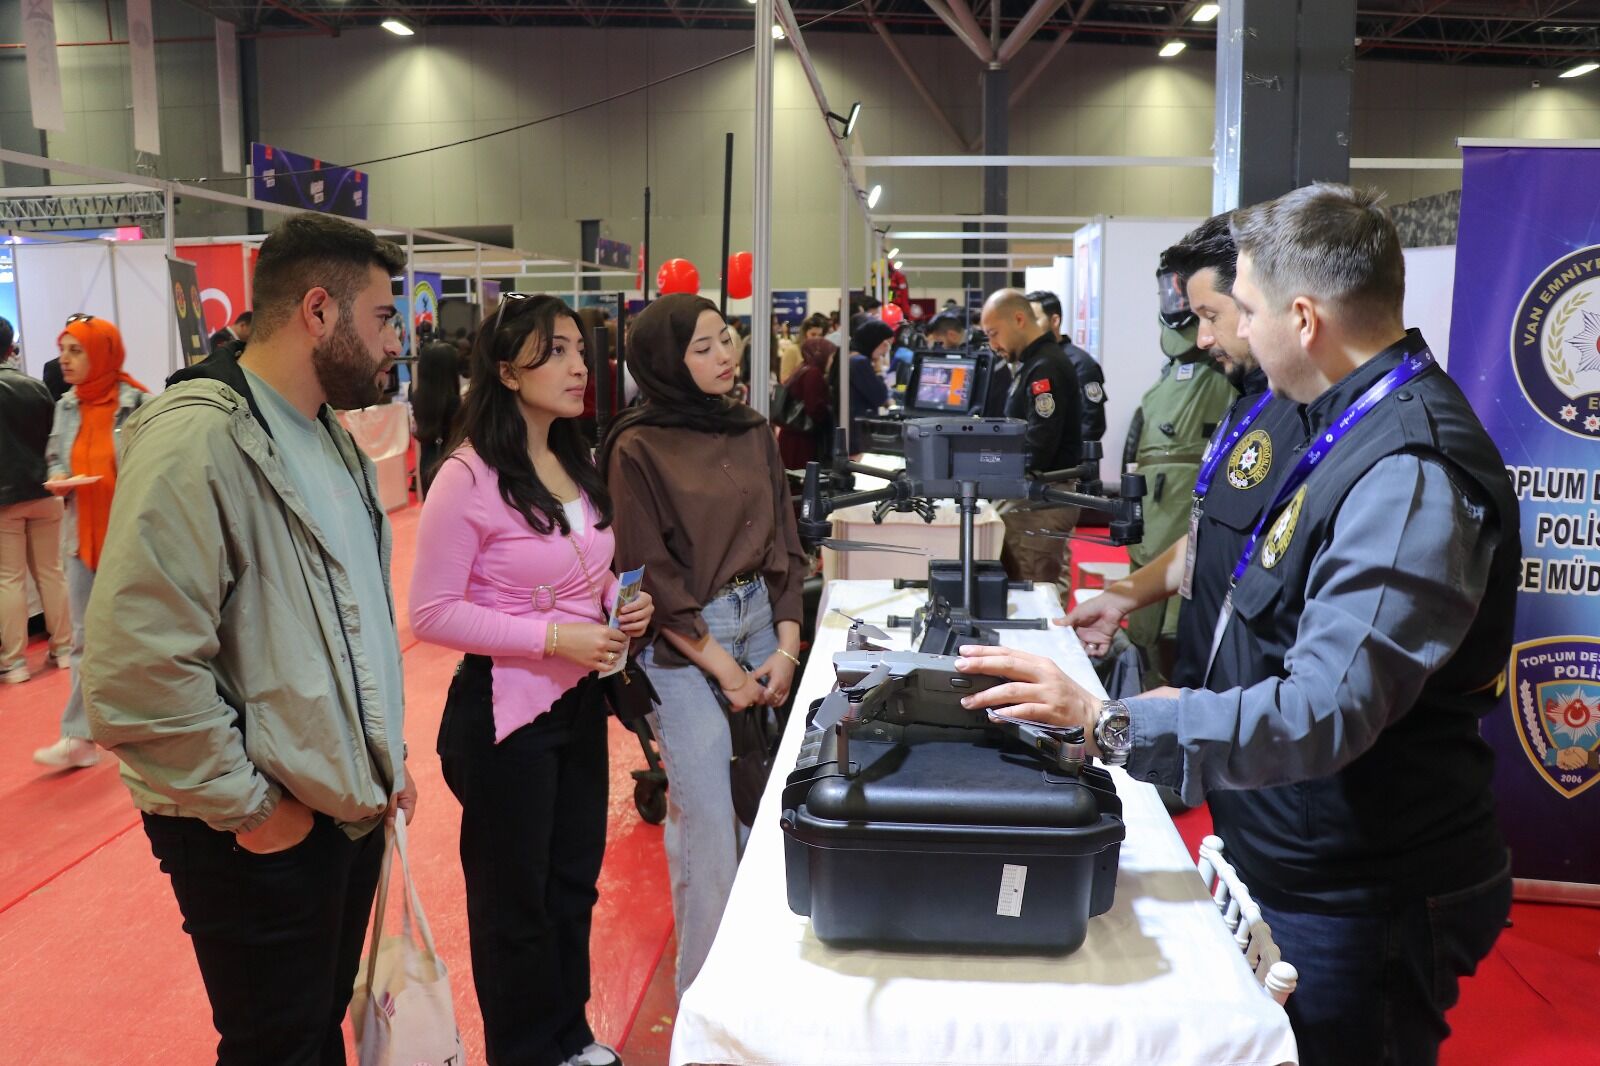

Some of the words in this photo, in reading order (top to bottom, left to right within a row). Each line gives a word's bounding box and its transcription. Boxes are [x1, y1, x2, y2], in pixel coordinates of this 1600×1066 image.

[1523, 306, 1544, 346] VAN
[1520, 651, 1576, 668] TOPLUM
[1560, 774, 1582, 784] 2006
